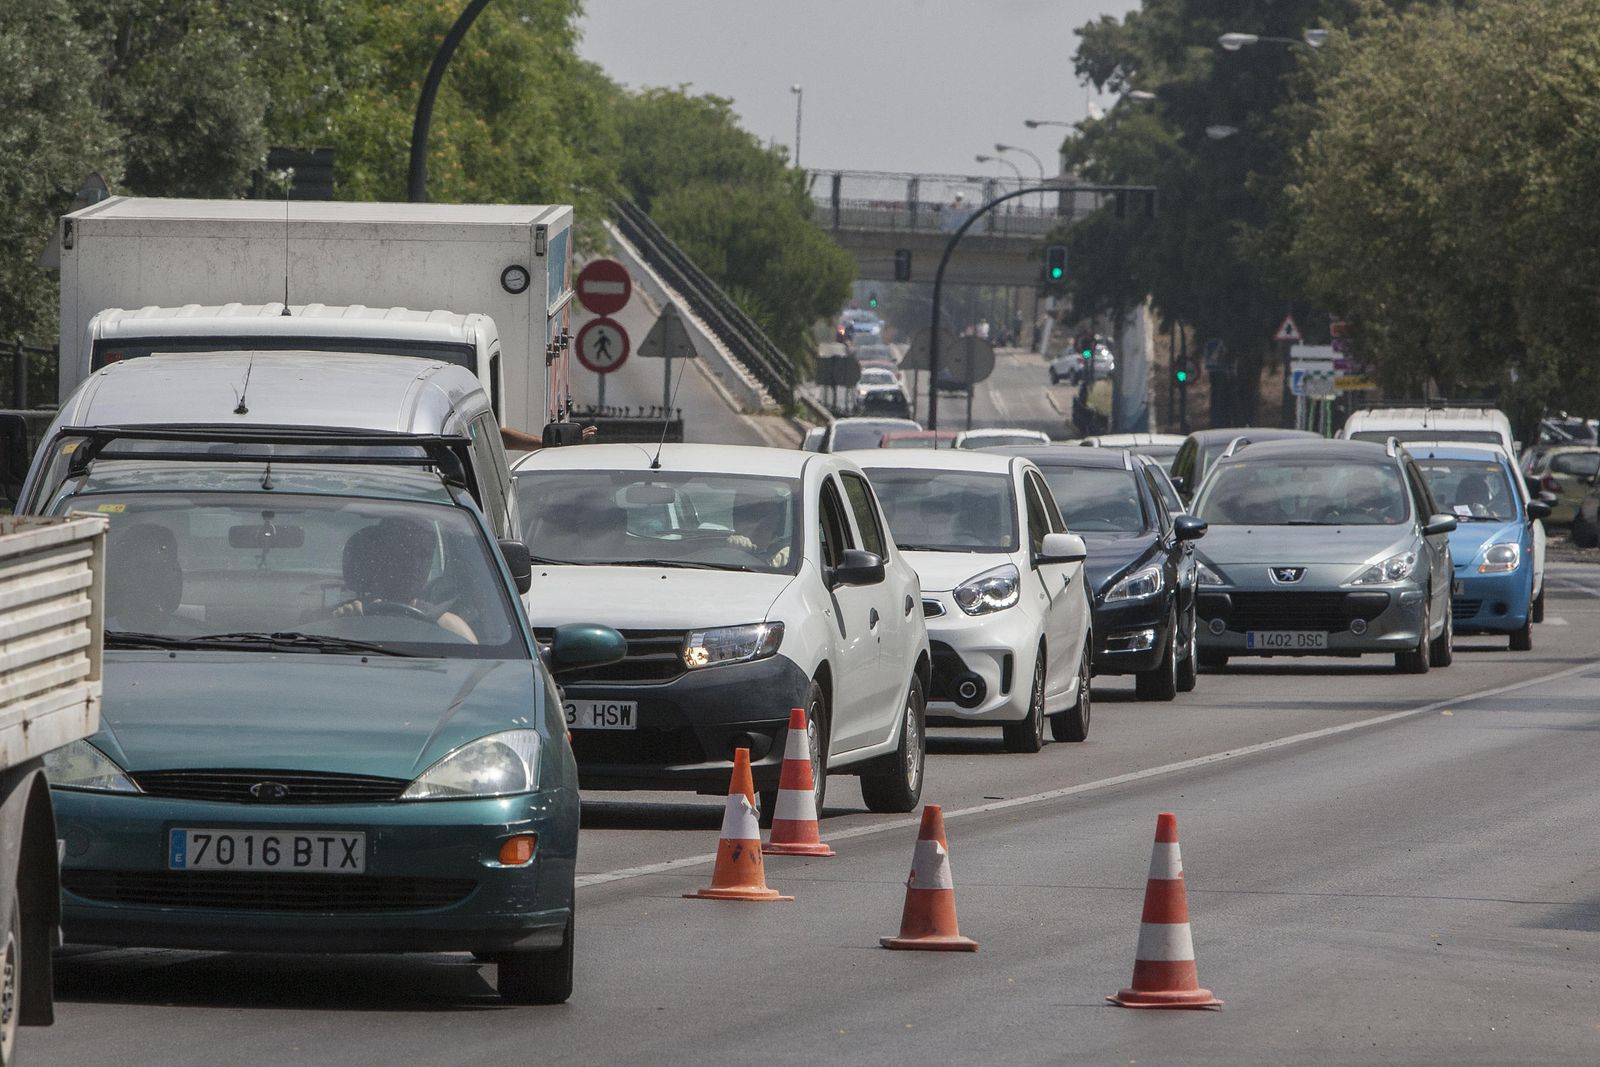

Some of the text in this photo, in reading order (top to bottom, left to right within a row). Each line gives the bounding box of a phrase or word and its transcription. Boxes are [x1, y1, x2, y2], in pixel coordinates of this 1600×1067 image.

[1260, 633, 1323, 647] 1402 DSC
[593, 704, 632, 727] HSW
[193, 834, 281, 866] 7016
[293, 836, 358, 868] BTX
